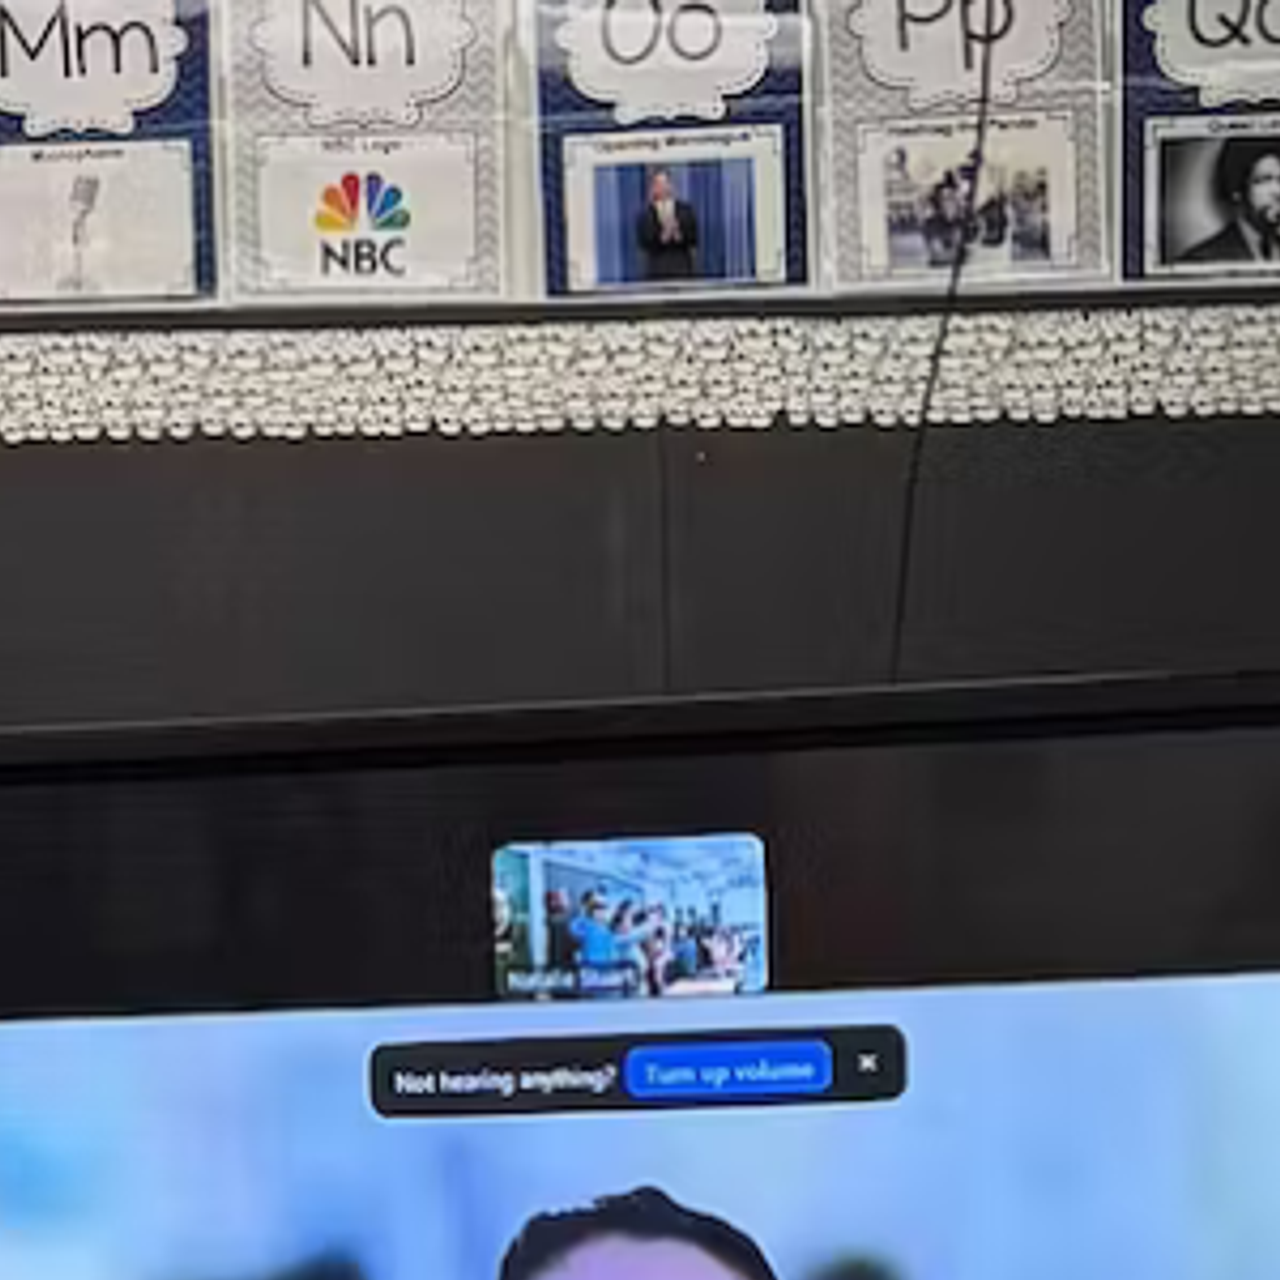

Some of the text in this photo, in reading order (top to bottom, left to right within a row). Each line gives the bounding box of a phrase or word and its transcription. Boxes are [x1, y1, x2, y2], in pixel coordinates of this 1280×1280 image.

[301, 0, 415, 67] Nn
[320, 238, 406, 276] NBC
[393, 1064, 618, 1098] Not hearing anything?
[644, 1059, 816, 1089] Turn up volume
